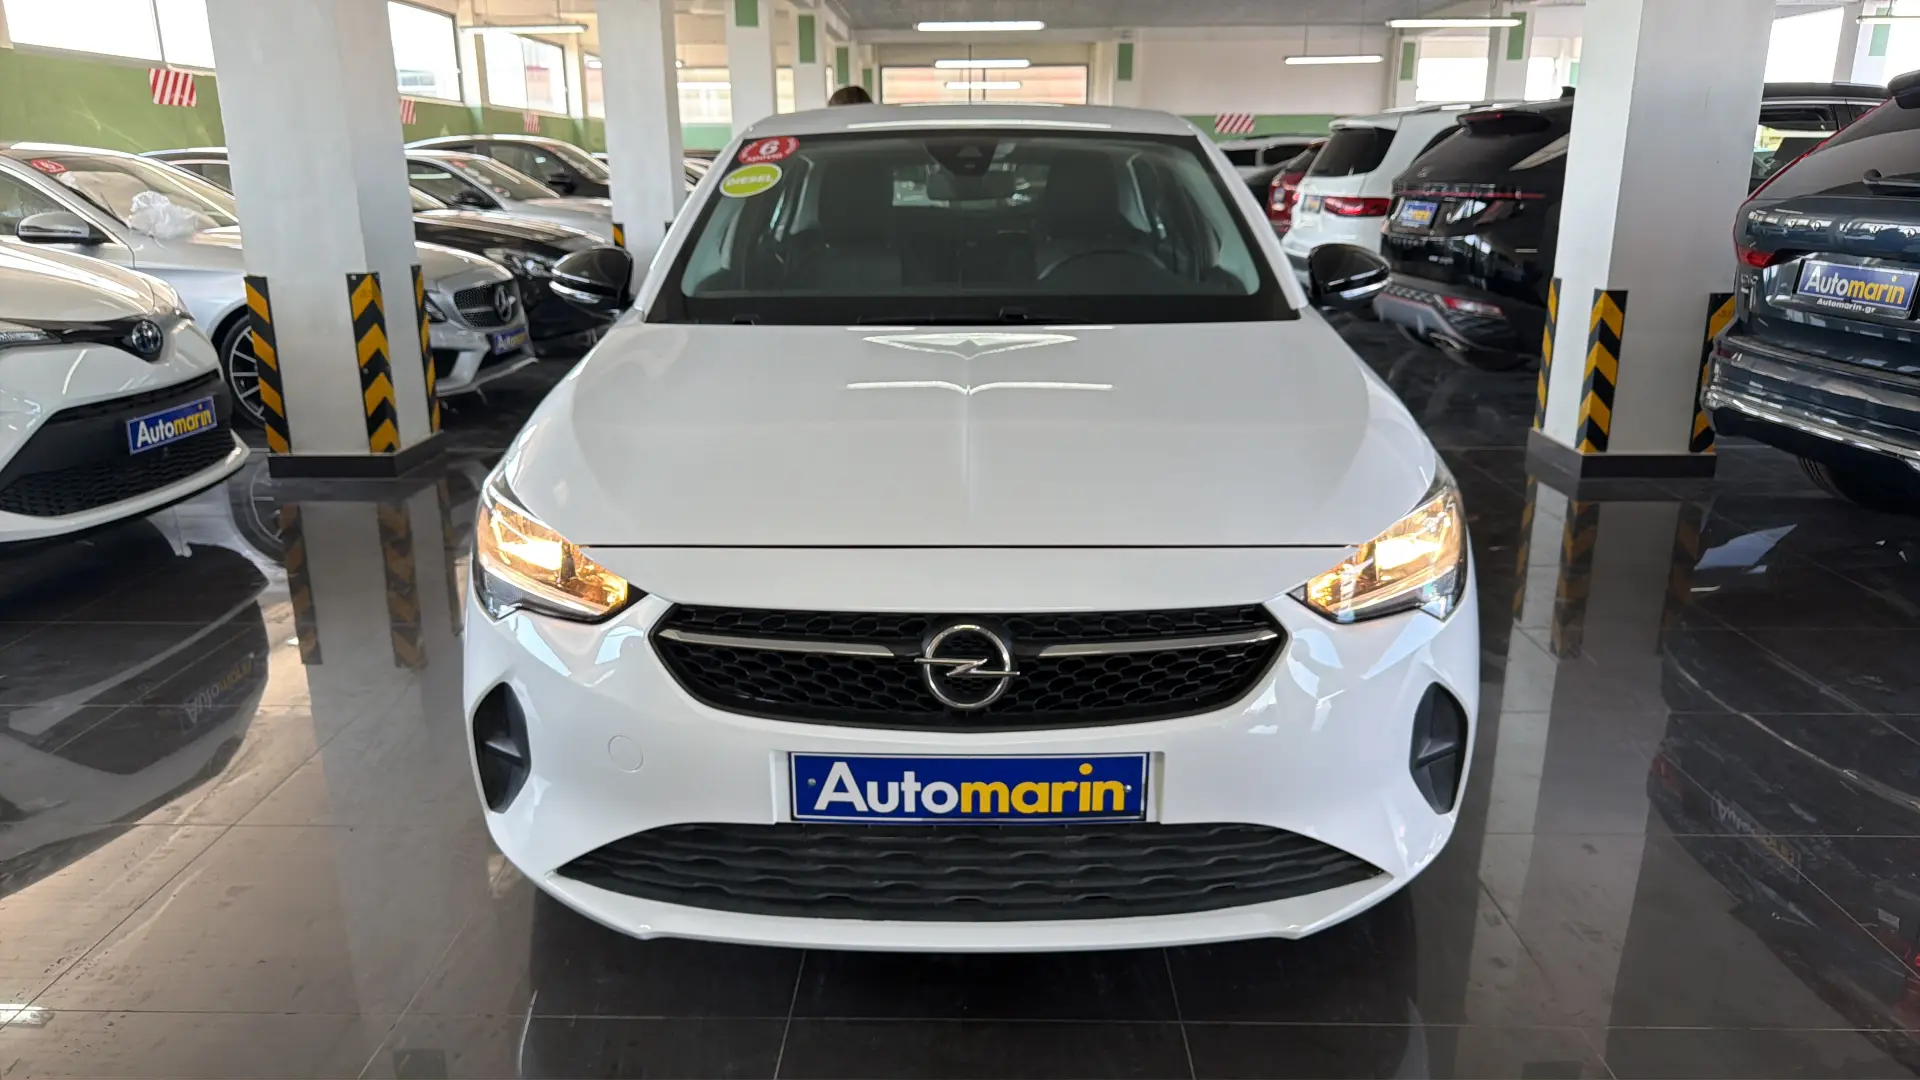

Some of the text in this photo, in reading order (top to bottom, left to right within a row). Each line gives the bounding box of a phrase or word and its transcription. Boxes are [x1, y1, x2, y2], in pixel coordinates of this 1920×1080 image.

[759, 140, 780, 156] 6
[726, 174, 772, 187] DIESEL
[1804, 265, 1905, 304] Automarin
[1816, 298, 1877, 314] Automarin.gr
[137, 404, 213, 448] Automarin
[813, 761, 1125, 814] Automarin
